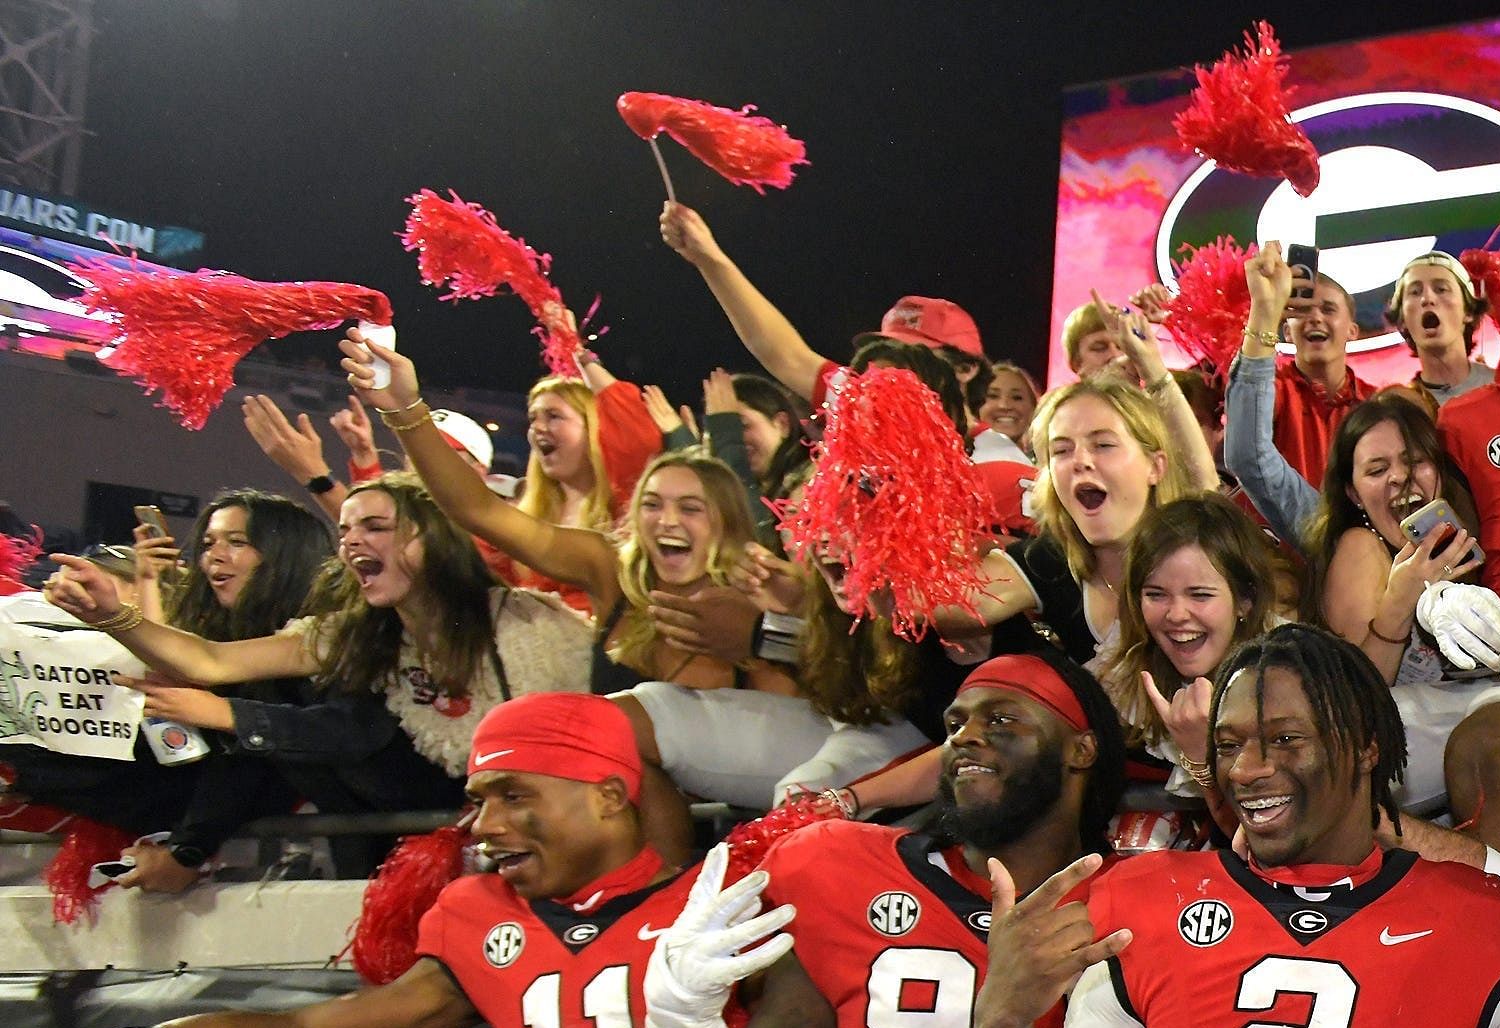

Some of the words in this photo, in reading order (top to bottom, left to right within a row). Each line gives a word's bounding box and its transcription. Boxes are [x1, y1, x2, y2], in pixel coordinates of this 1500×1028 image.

[59, 692, 104, 711] EAT
[37, 715, 132, 740] BOOGERS
[870, 893, 917, 935] SEC
[1180, 902, 1232, 944] SEC
[1289, 910, 1328, 933] G
[486, 924, 523, 966] SEC
[564, 923, 599, 944] G
